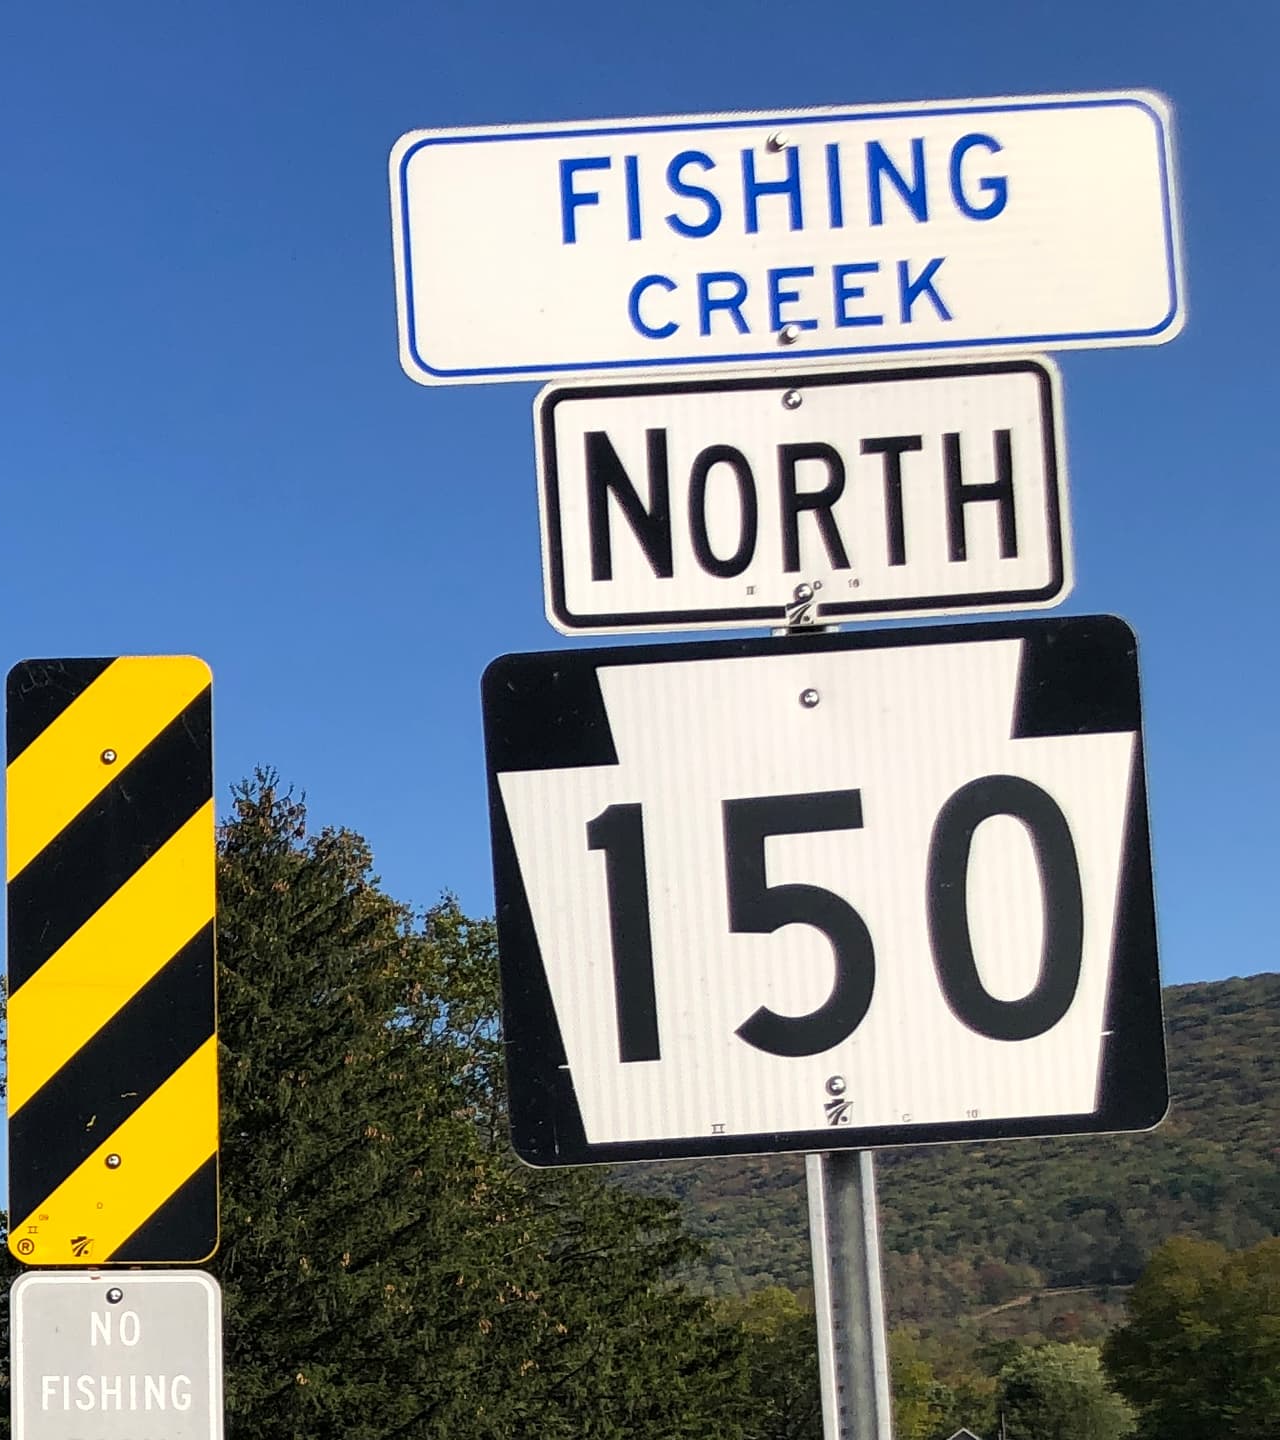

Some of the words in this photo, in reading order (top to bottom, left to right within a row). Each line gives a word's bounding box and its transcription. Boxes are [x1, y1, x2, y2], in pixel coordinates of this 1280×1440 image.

[558, 131, 1010, 245] FISHING
[627, 257, 953, 341] CREEK
[584, 427, 1019, 581] NORTH
[586, 773, 1085, 1063] 150
[90, 1311, 141, 1347] NO
[41, 1374, 192, 1411] FISHING
